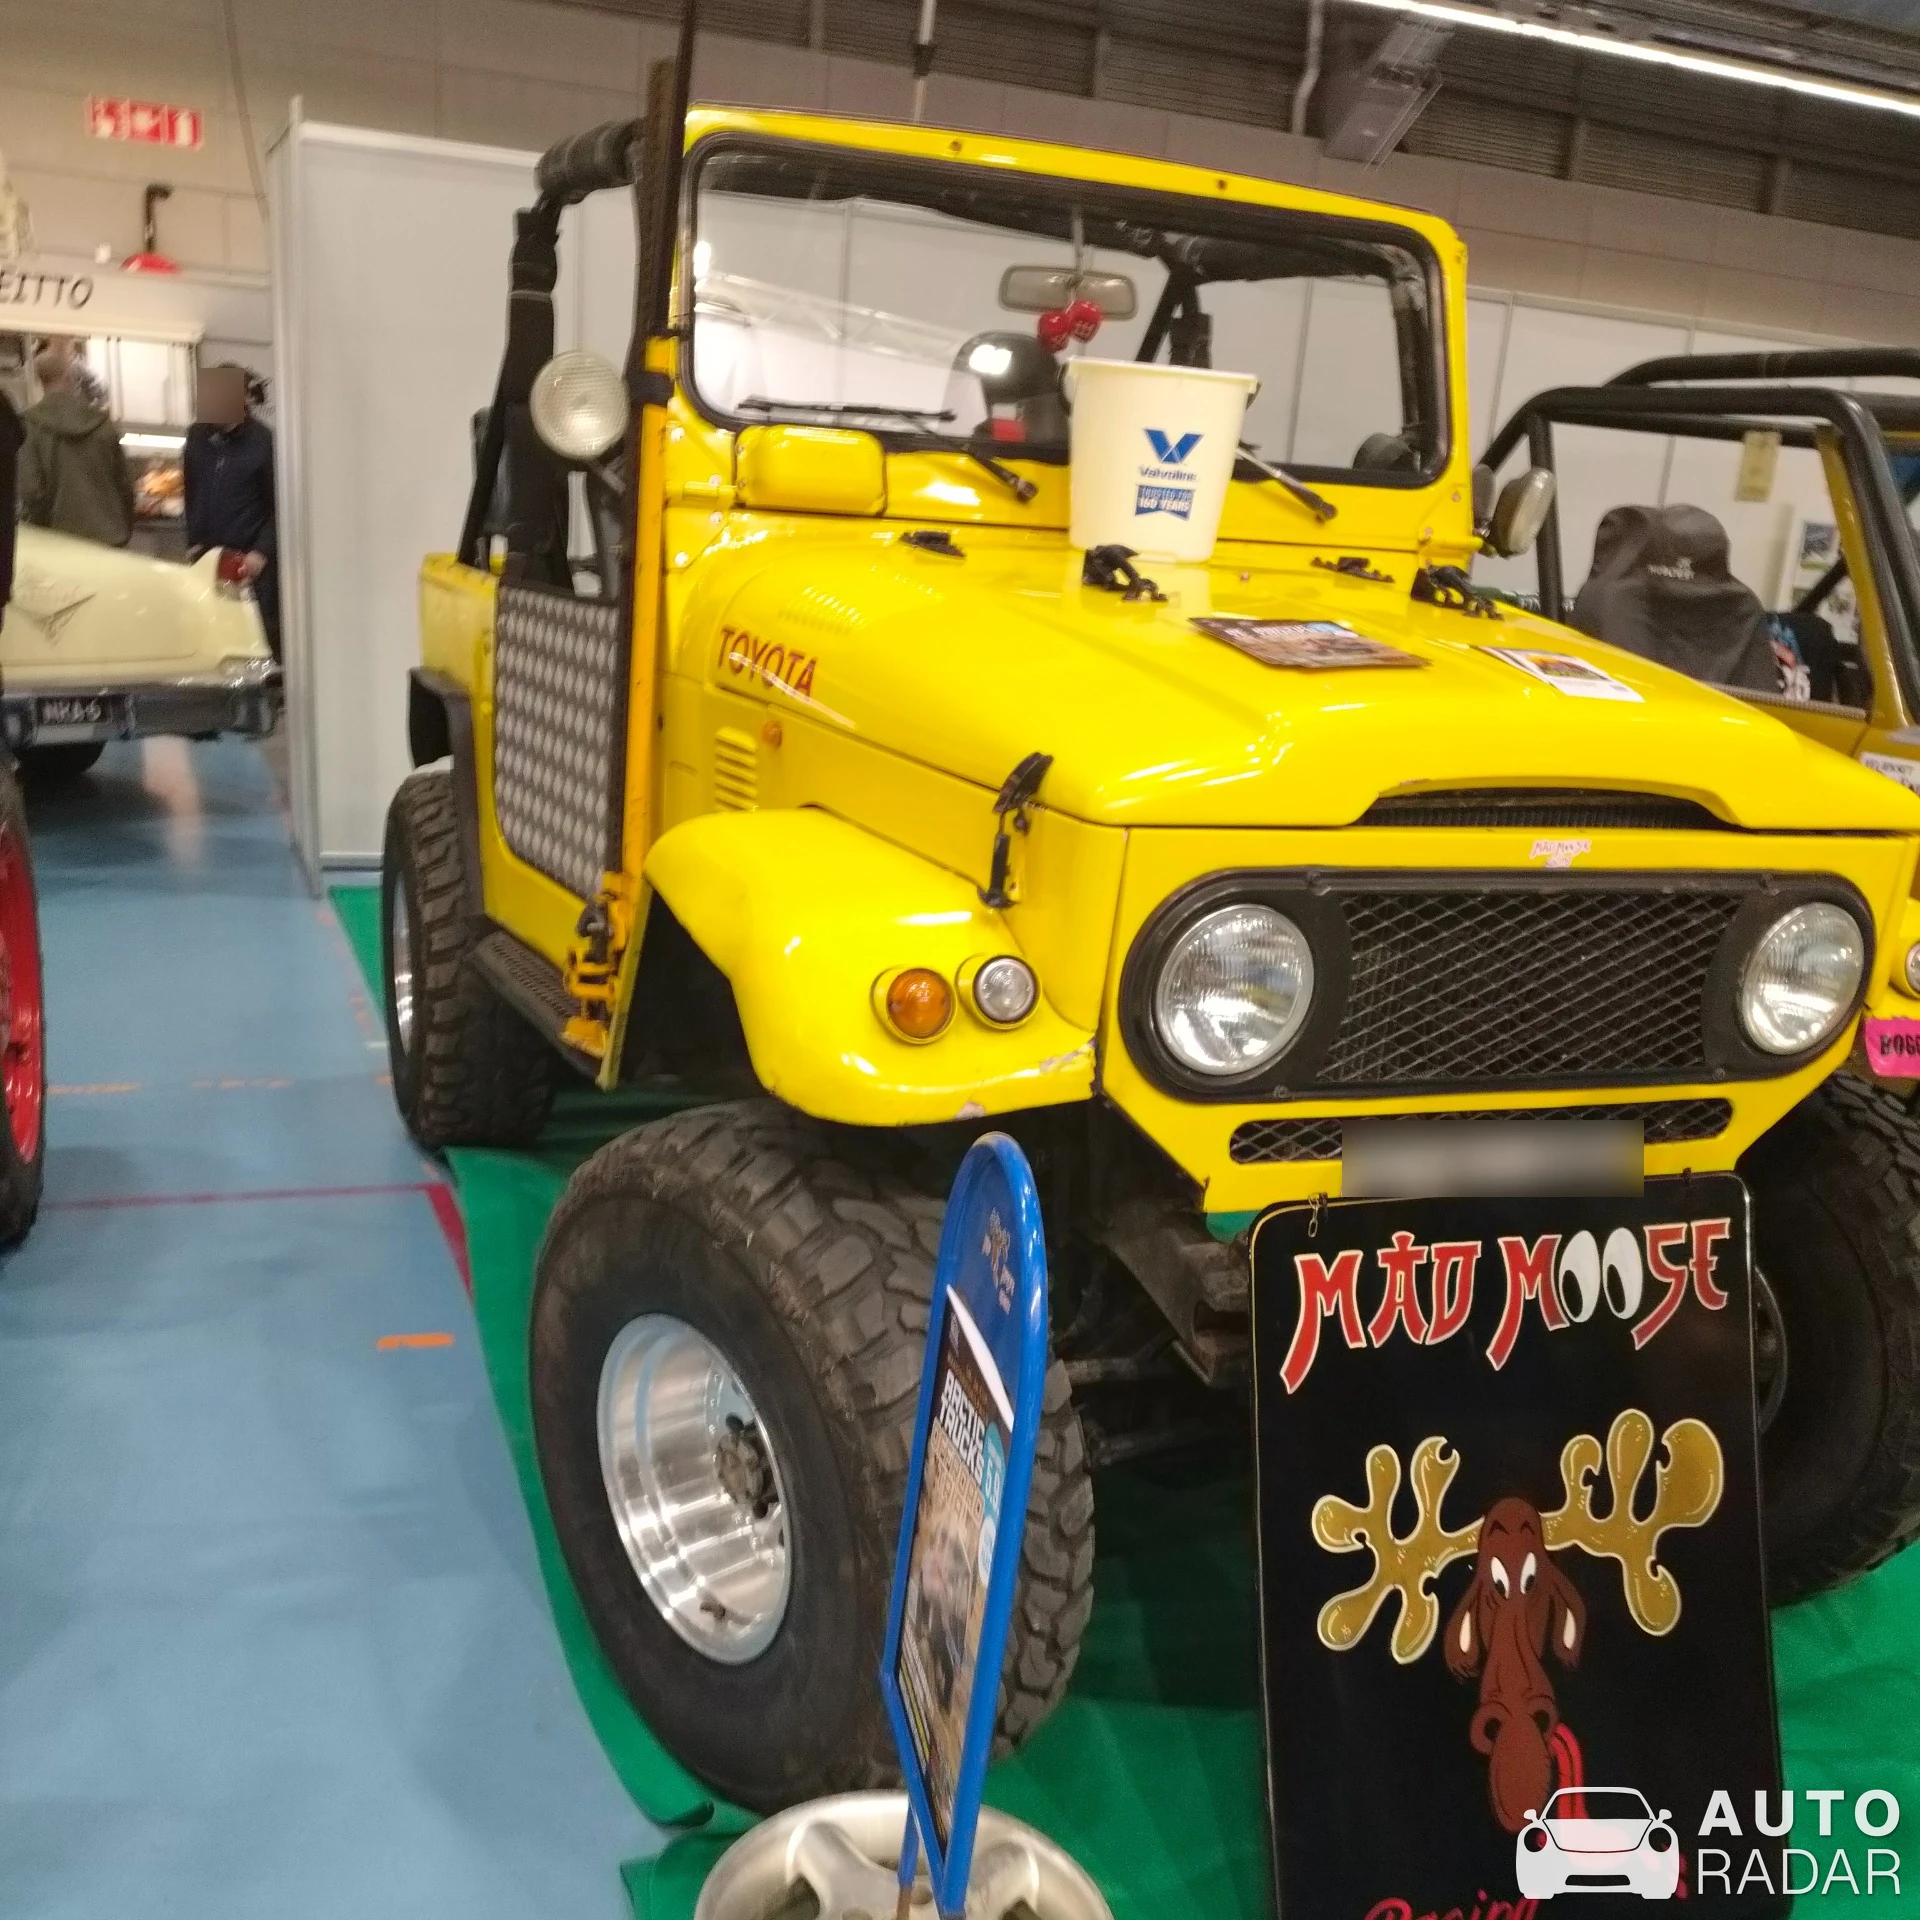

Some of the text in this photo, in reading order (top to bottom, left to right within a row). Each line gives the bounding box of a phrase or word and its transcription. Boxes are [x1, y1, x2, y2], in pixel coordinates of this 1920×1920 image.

[1138, 466, 1198, 482] Valvoline
[1161, 499, 1191, 513] YEARS
[717, 625, 818, 702] TOYOTA
[1280, 1217, 1731, 1395] MAD MOOSE
[939, 1391, 985, 1487] TRUCKS
[944, 1368, 986, 1450] ARCTIC
